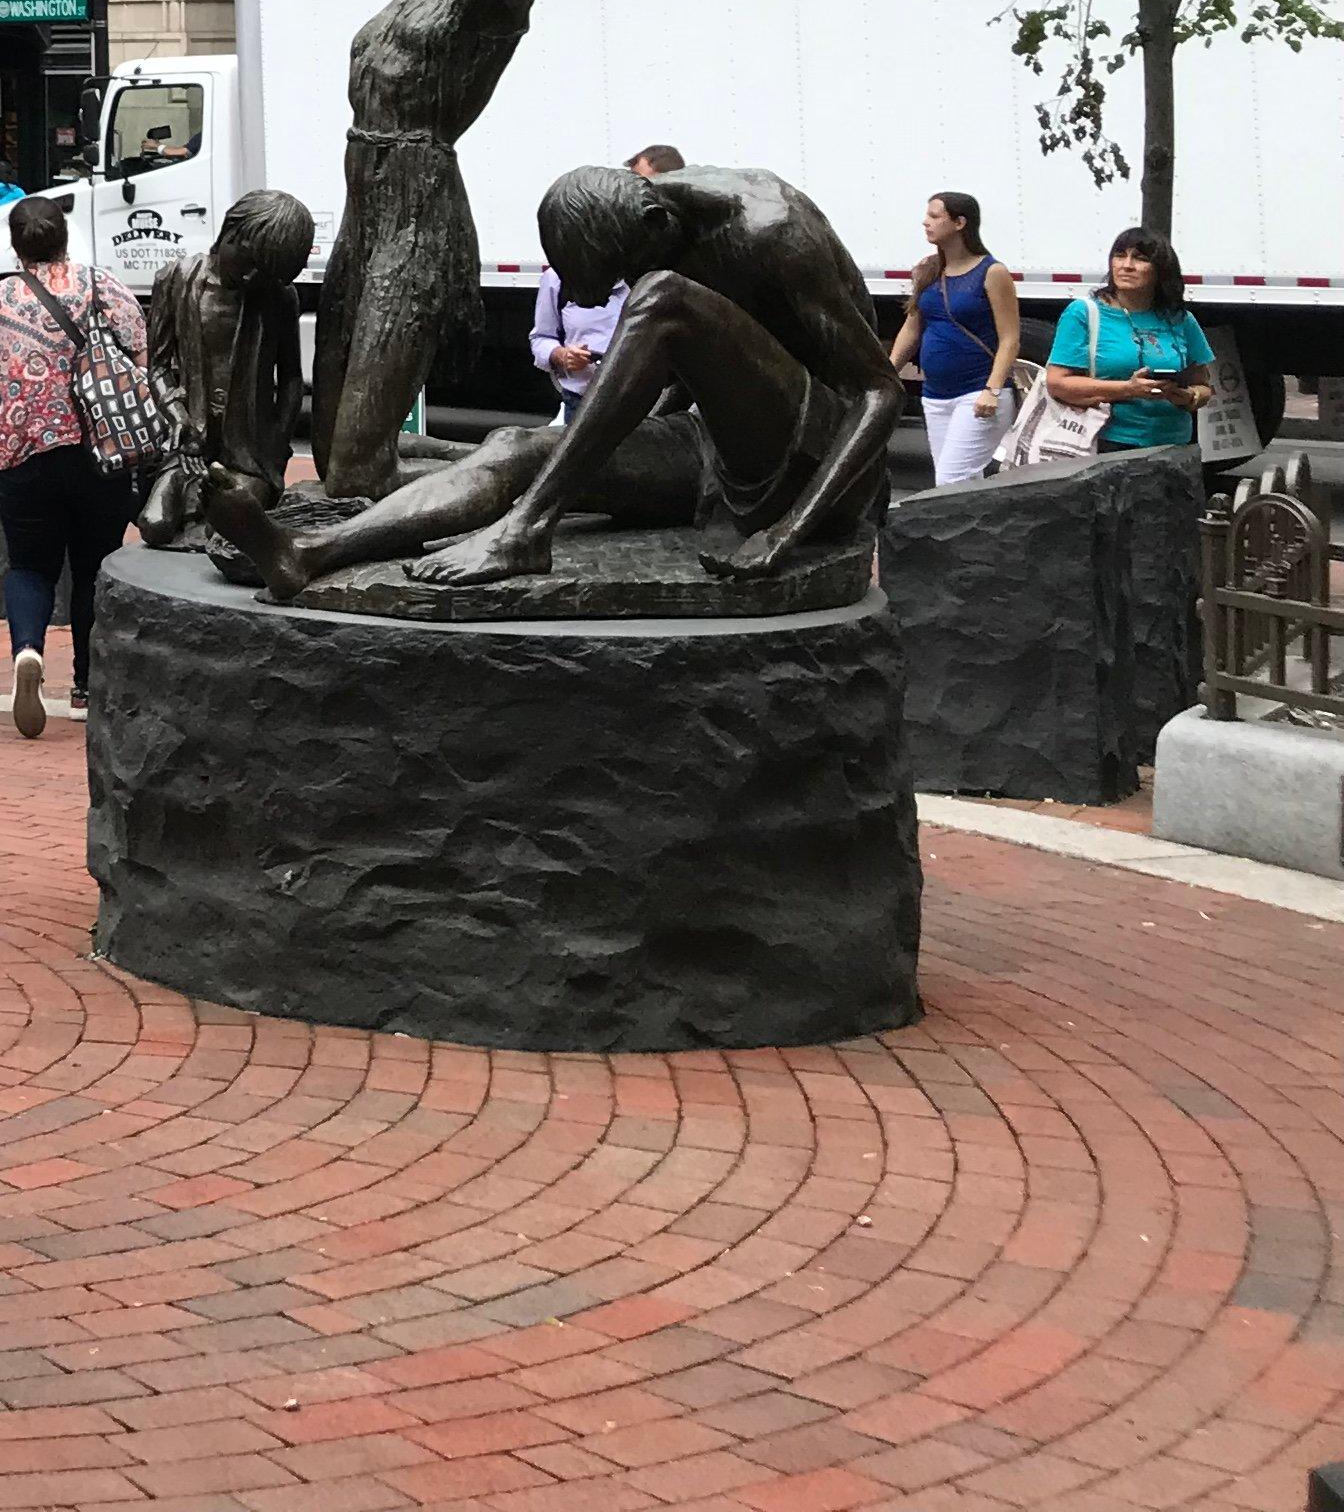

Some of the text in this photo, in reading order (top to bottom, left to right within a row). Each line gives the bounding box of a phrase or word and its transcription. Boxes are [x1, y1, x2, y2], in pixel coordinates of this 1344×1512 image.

[9, 0, 77, 17] WASHINGTON
[112, 229, 184, 246] DELIVERY
[115, 248, 129, 258] US
[131, 248, 150, 258] DOT
[123, 260, 139, 270] MC
